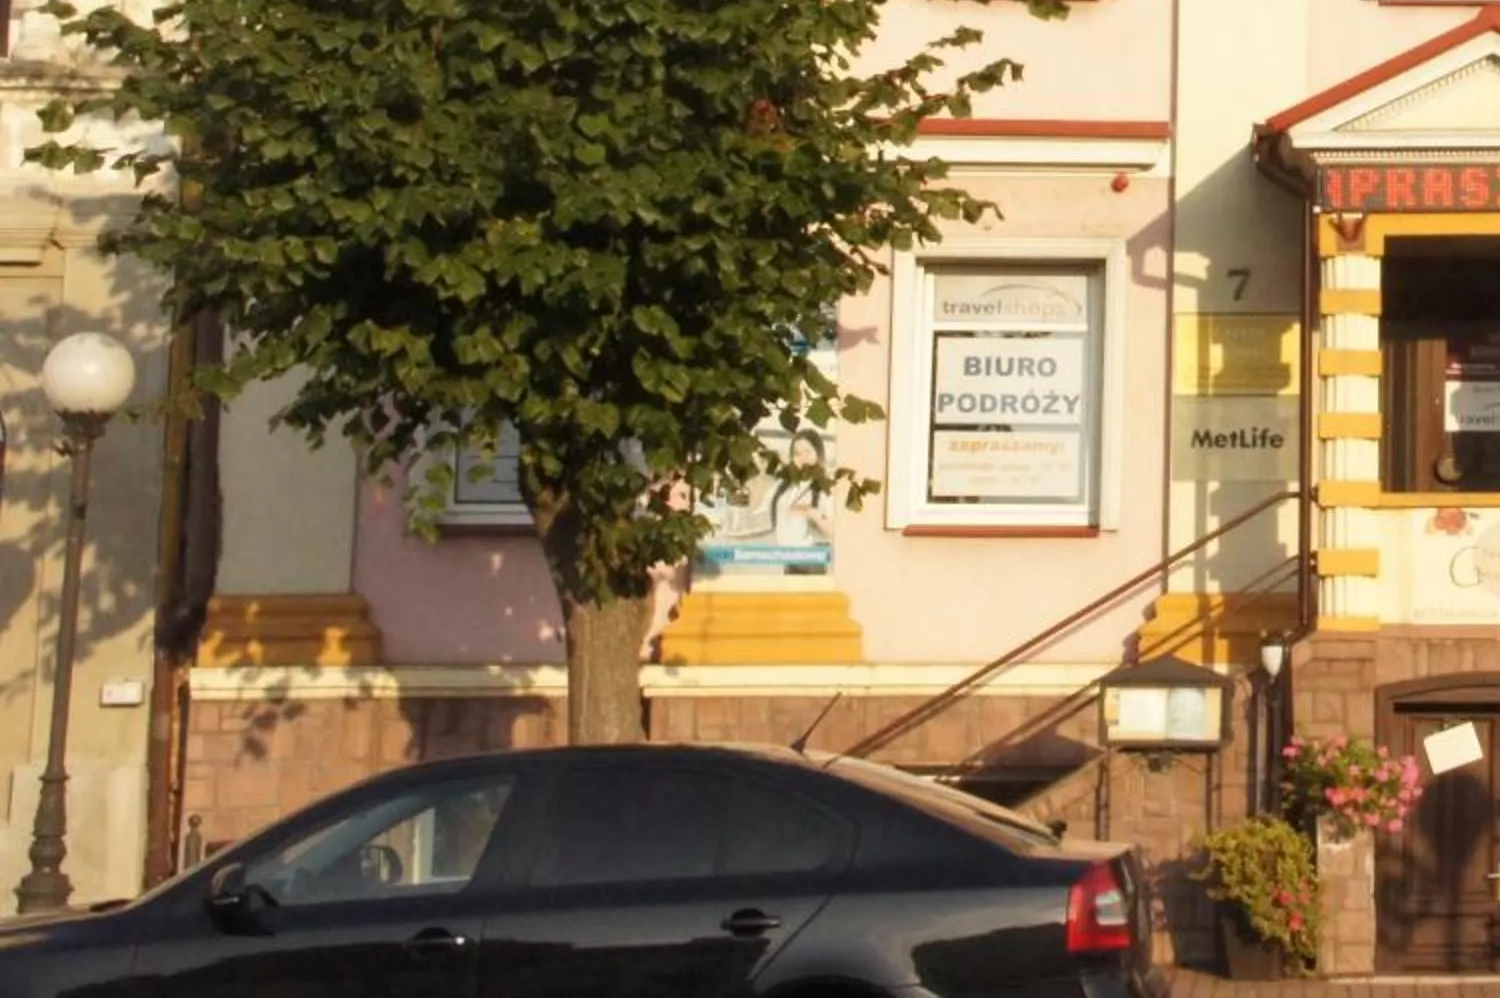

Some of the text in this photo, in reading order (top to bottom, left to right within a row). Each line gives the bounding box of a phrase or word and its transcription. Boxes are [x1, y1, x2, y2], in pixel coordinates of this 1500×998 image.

[1227, 267, 1251, 302] 7
[963, 355, 1057, 377] BIURO
[937, 388, 1080, 414] PODRÓŻY
[1191, 426, 1284, 449] MetLife
